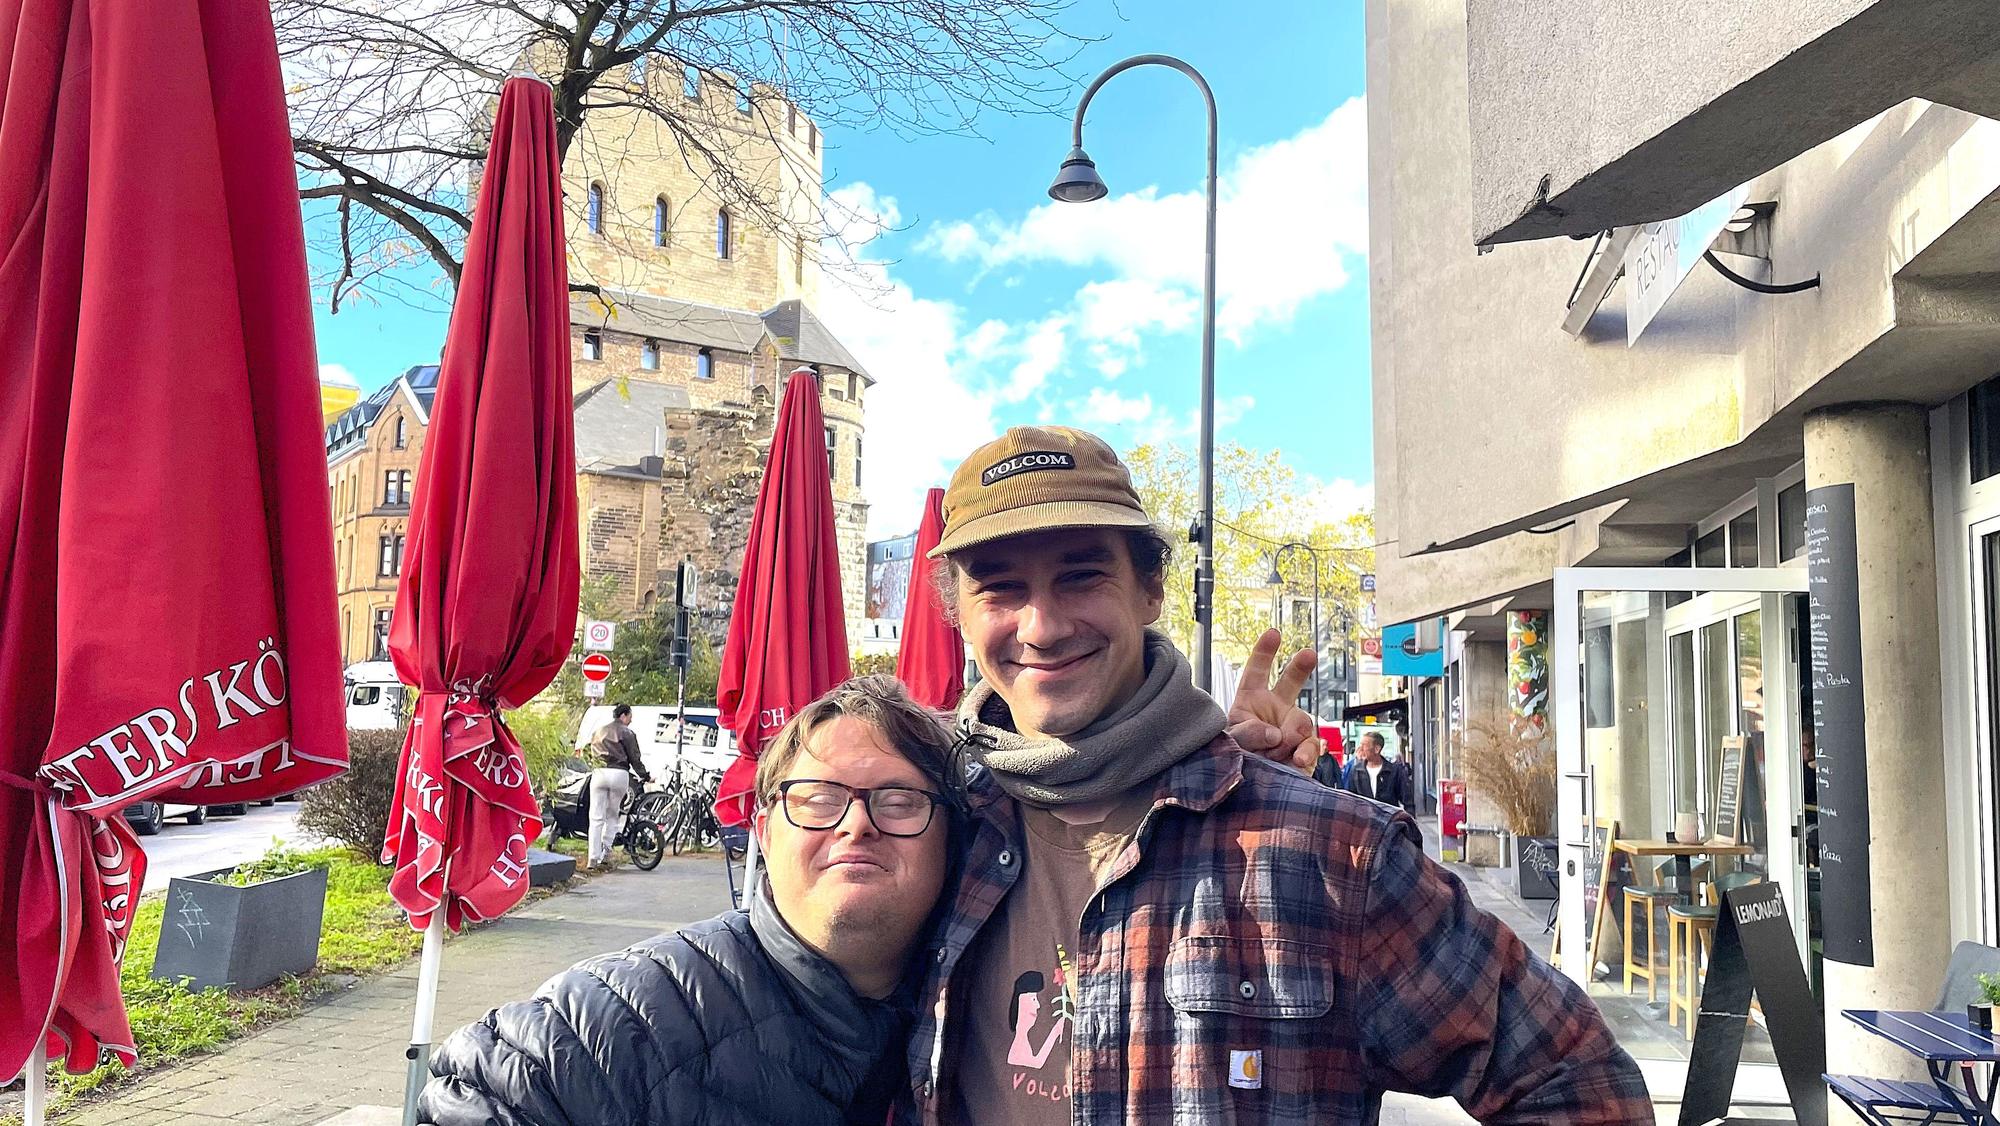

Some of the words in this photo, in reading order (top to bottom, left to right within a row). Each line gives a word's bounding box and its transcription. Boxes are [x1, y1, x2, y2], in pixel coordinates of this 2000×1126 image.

[986, 454, 1069, 479] VOLCOM
[594, 628, 605, 638] 20
[1826, 672, 1851, 686] Pasta
[760, 707, 786, 729] CH
[1822, 844, 1843, 863] Pizza
